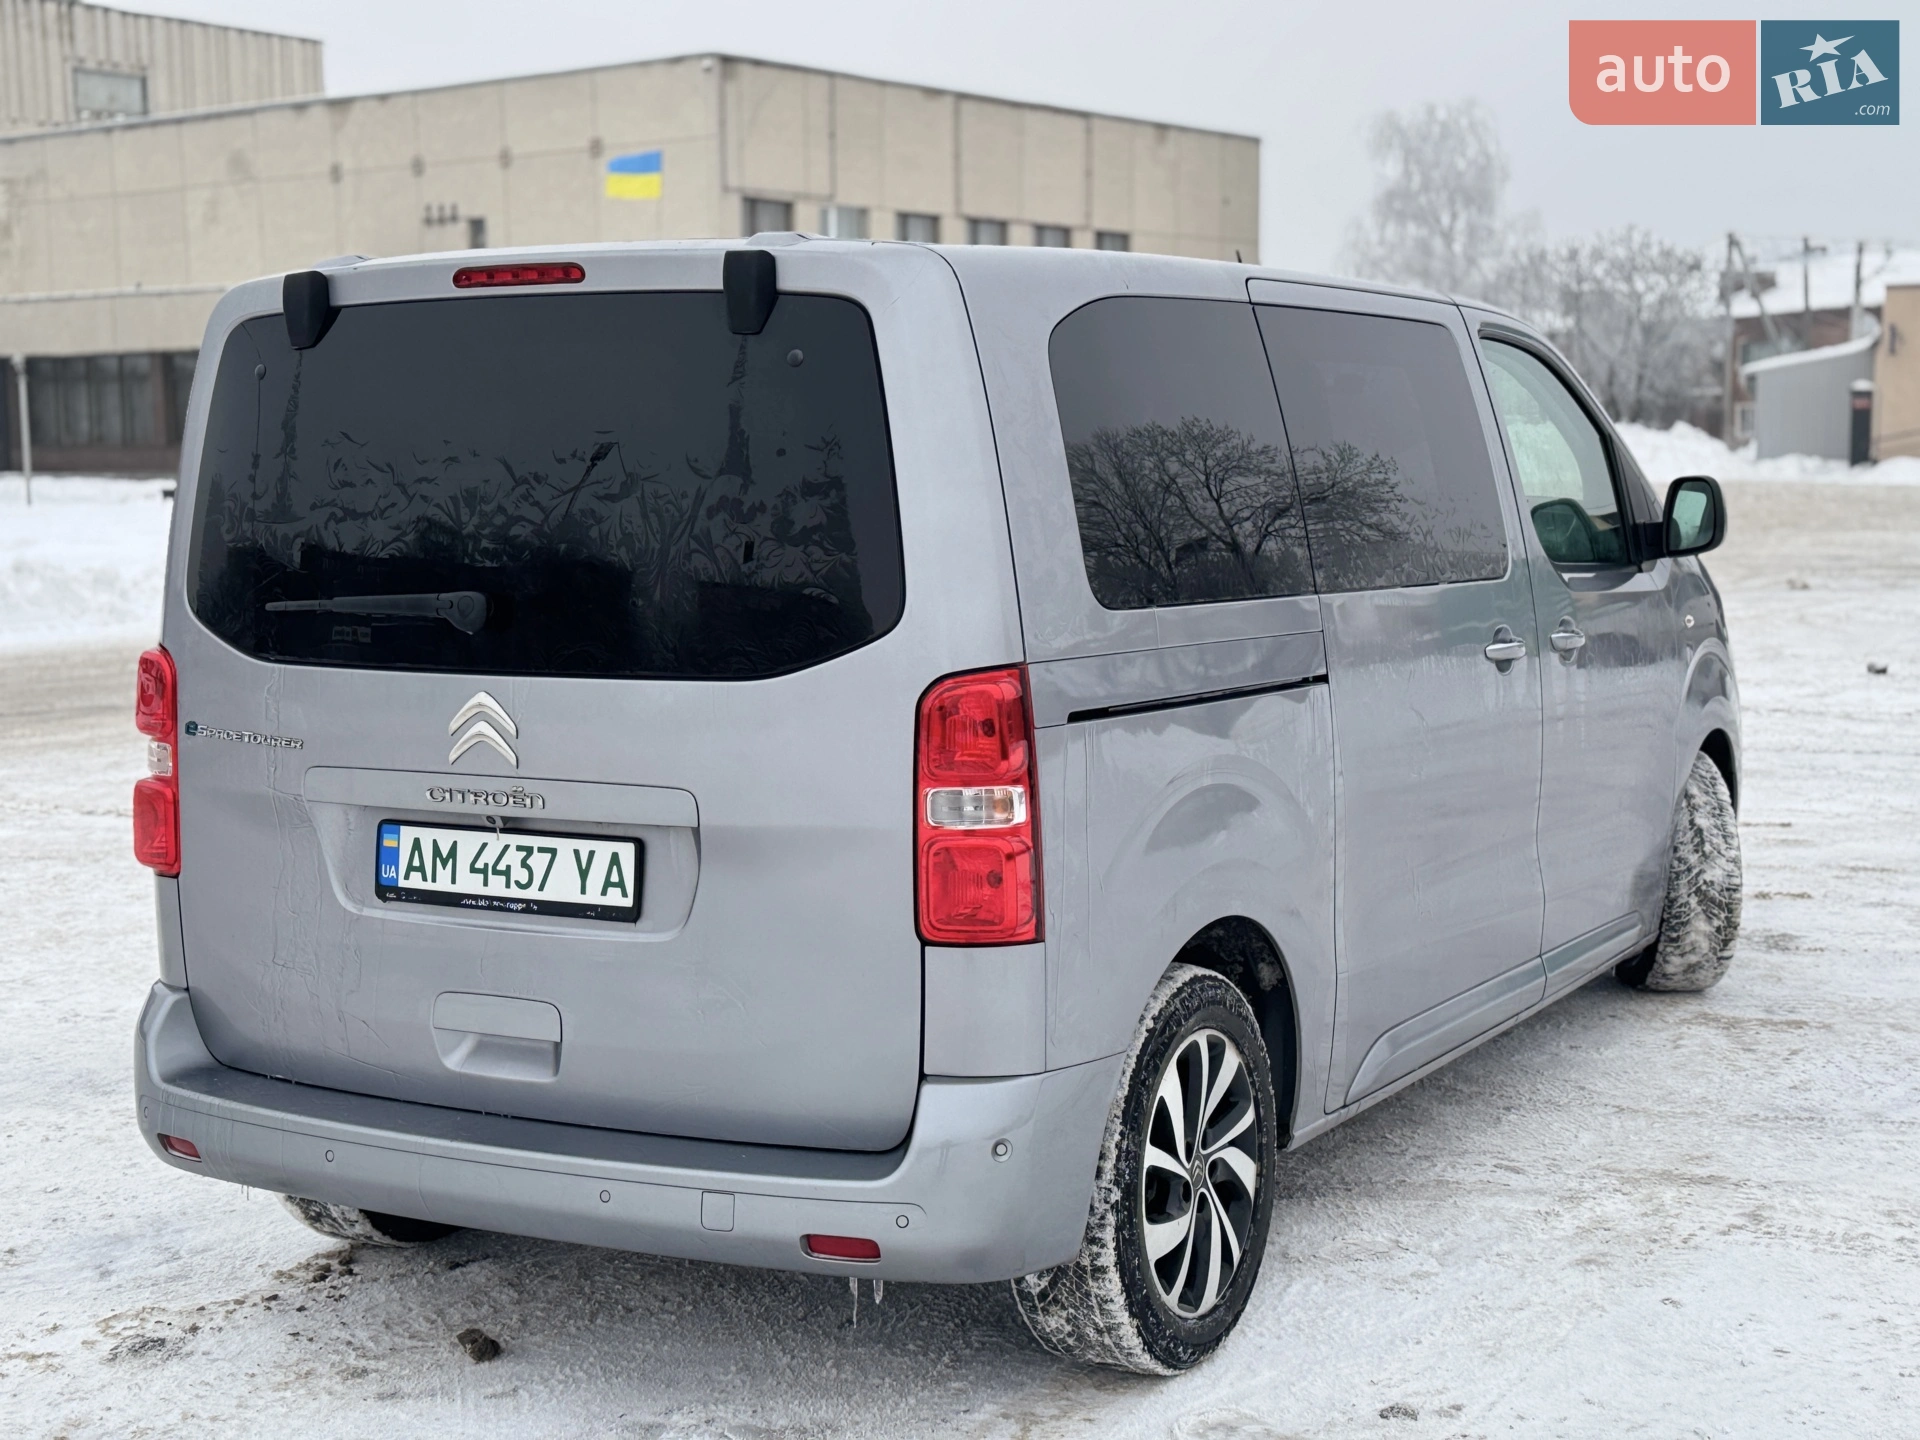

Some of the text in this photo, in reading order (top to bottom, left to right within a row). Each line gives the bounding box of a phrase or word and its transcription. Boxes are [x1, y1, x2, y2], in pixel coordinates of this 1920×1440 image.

[425, 785, 545, 809] CITROËN
[382, 864, 397, 879] UA
[403, 836, 628, 898] AM 4437 YA
